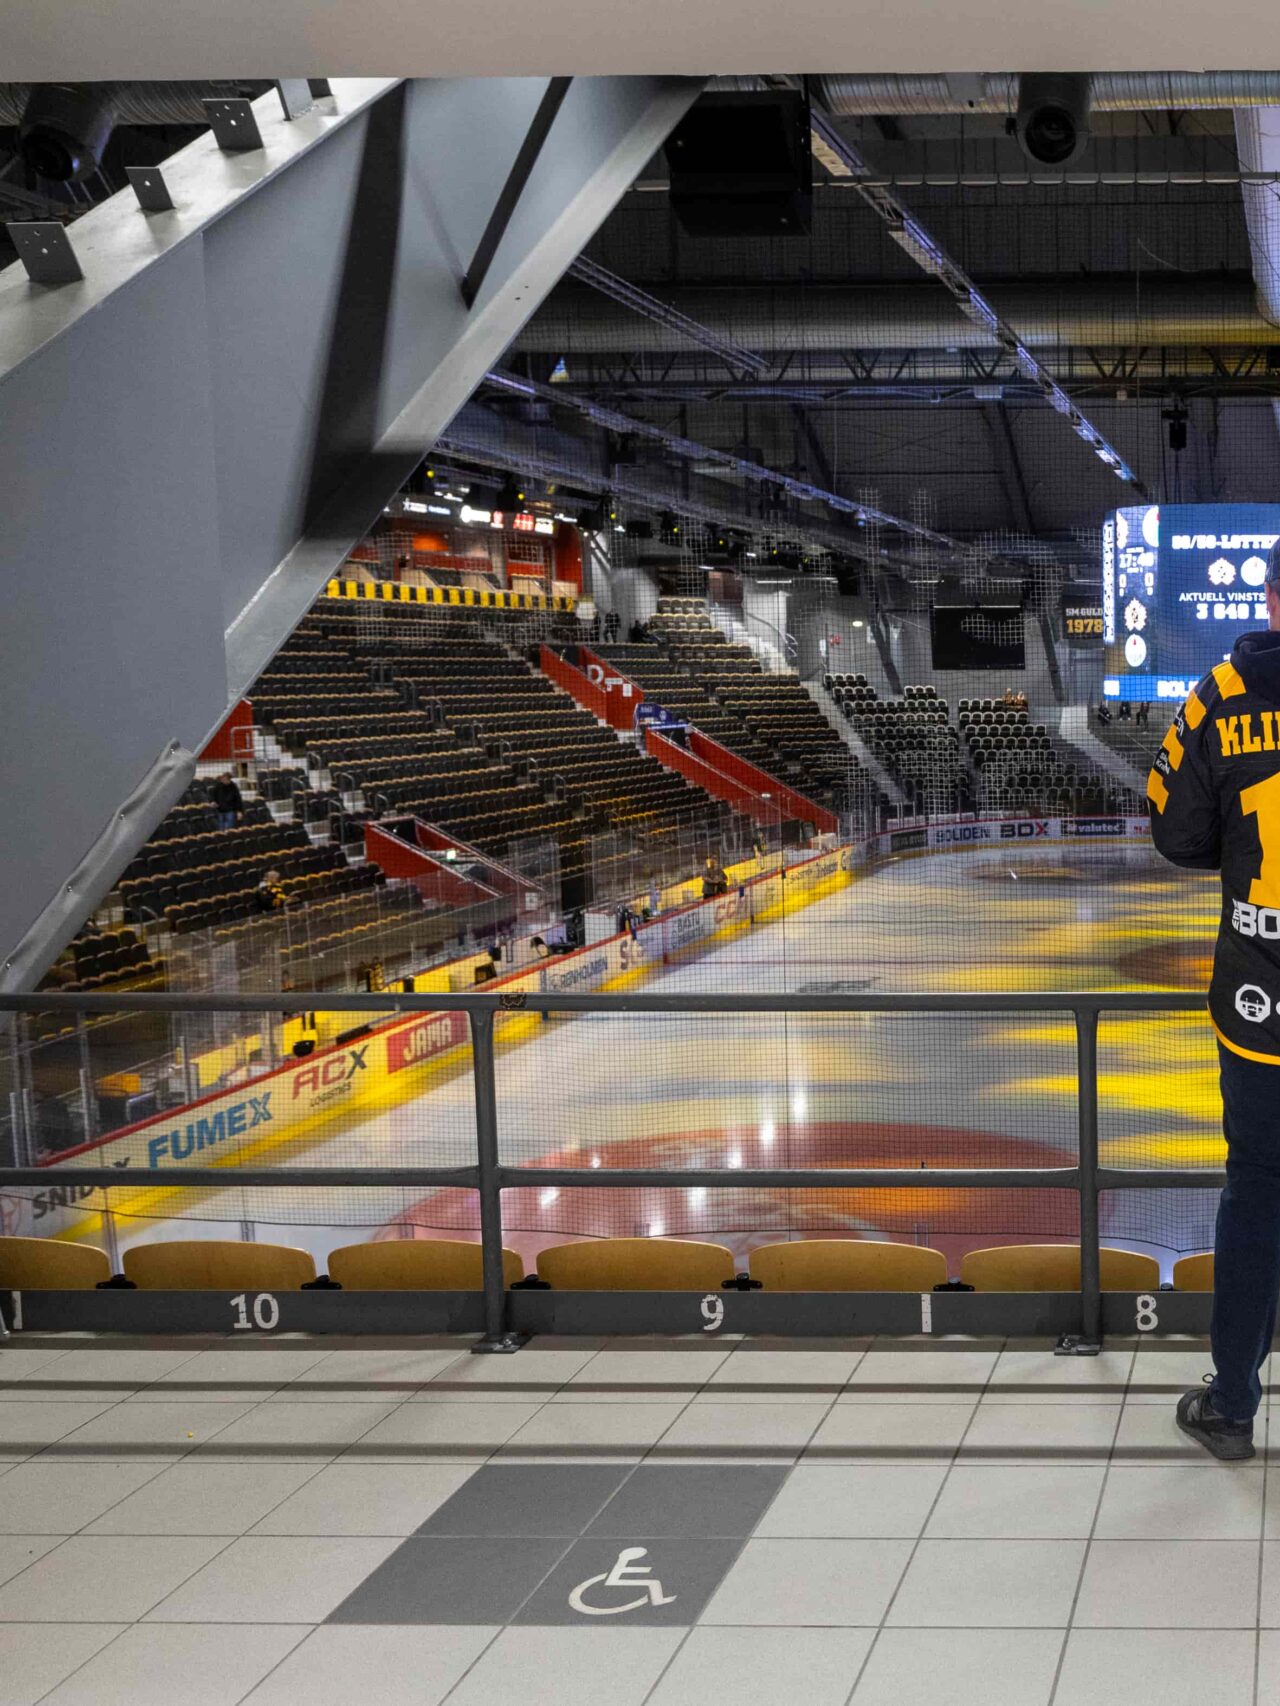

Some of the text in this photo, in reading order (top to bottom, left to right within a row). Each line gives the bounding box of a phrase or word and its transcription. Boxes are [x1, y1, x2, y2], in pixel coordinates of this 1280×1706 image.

[1179, 592, 1266, 602] AKTUELL VINSTS
[1066, 618, 1104, 634] 1978
[1000, 822, 1049, 838] BDX
[403, 1017, 452, 1061] JAMA
[292, 1044, 369, 1100] ACX
[148, 1092, 272, 1168] FUMEX
[230, 1293, 279, 1330] 10
[700, 1294, 724, 1331] 9
[1136, 1295, 1159, 1332] 8
